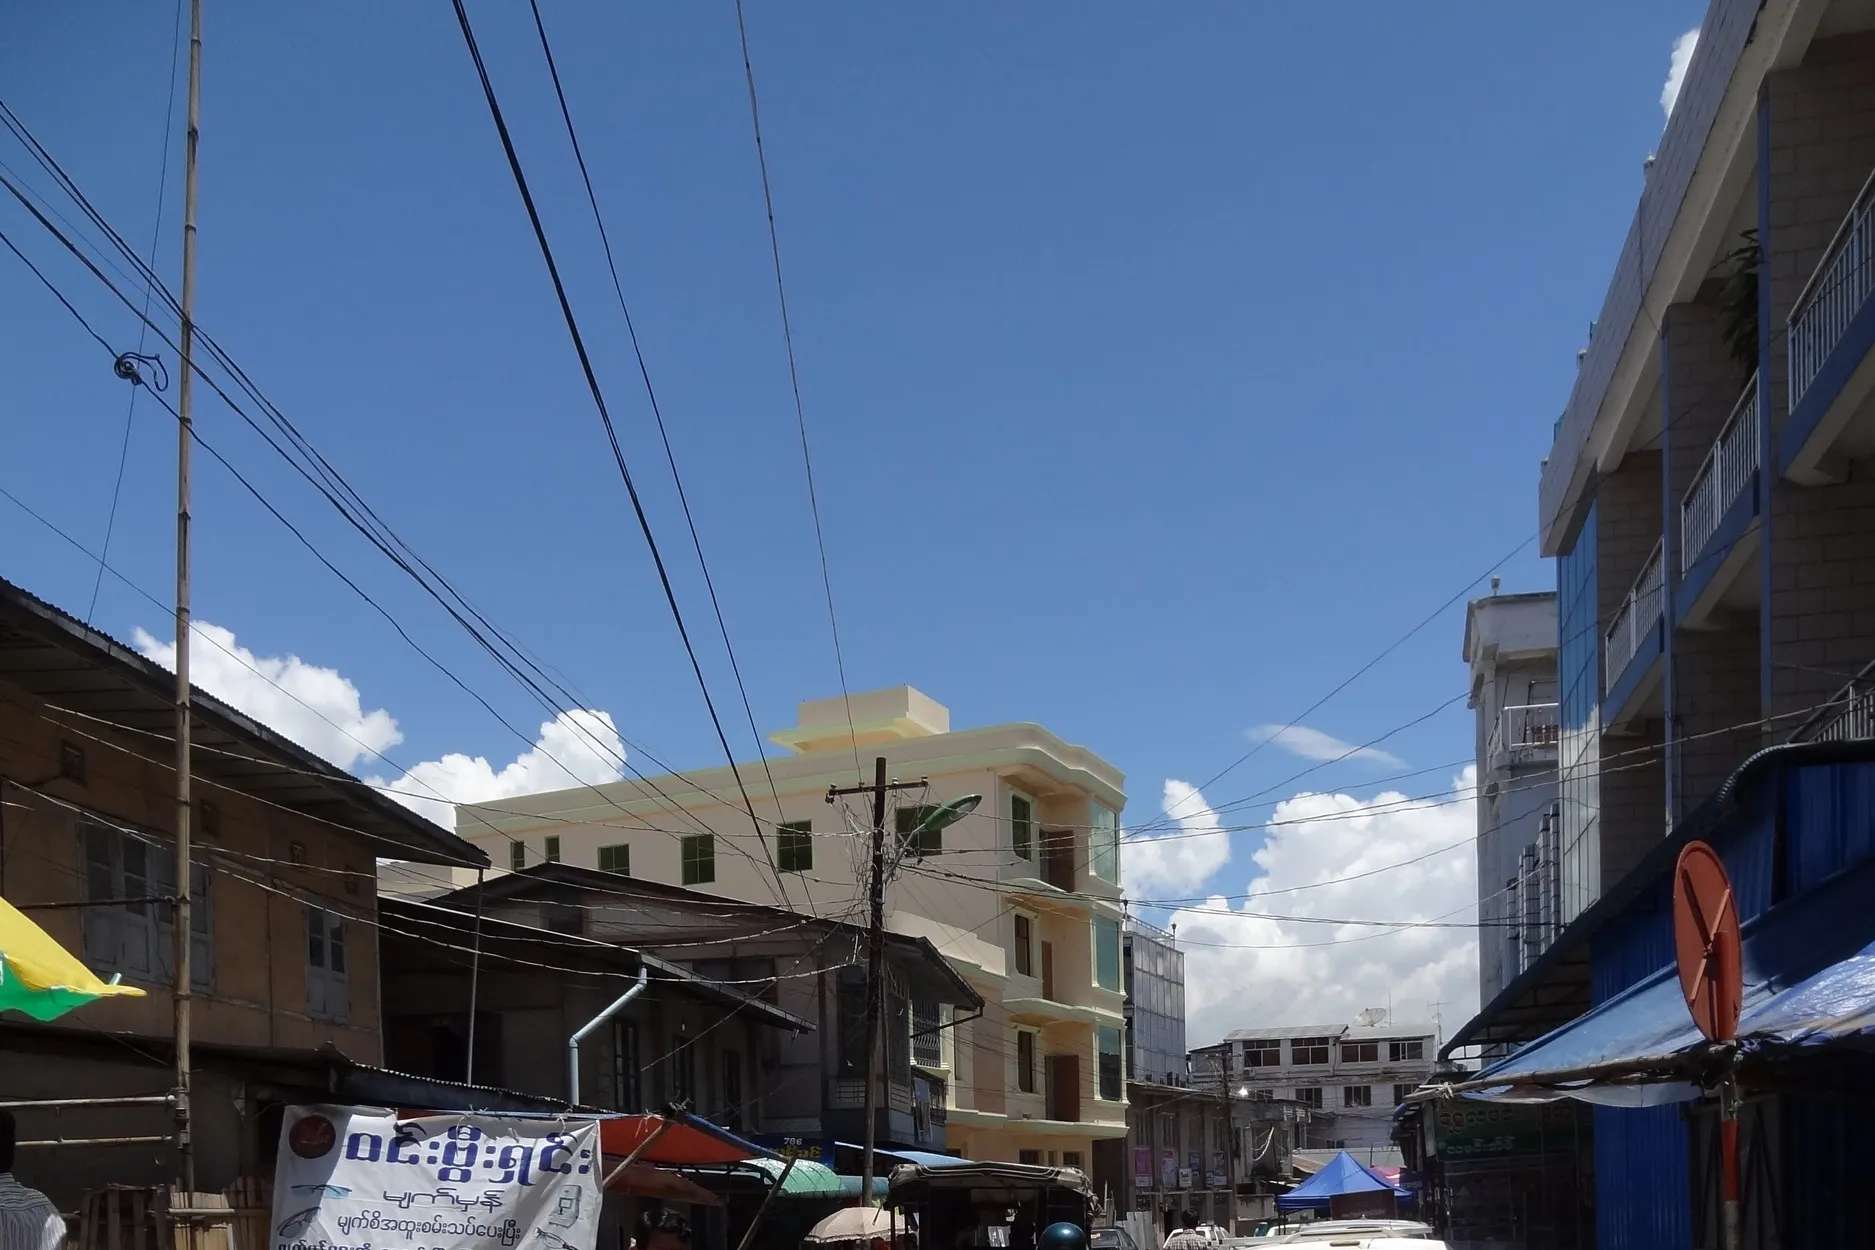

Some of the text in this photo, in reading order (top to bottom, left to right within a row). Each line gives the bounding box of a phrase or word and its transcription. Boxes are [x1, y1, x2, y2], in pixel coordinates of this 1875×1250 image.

[783, 1136, 804, 1146] 786
[382, 1187, 506, 1214] မျက်မှန်
[336, 1209, 522, 1247] မျက်စိအထူးစမ်းသပ်ပေးပြီး
